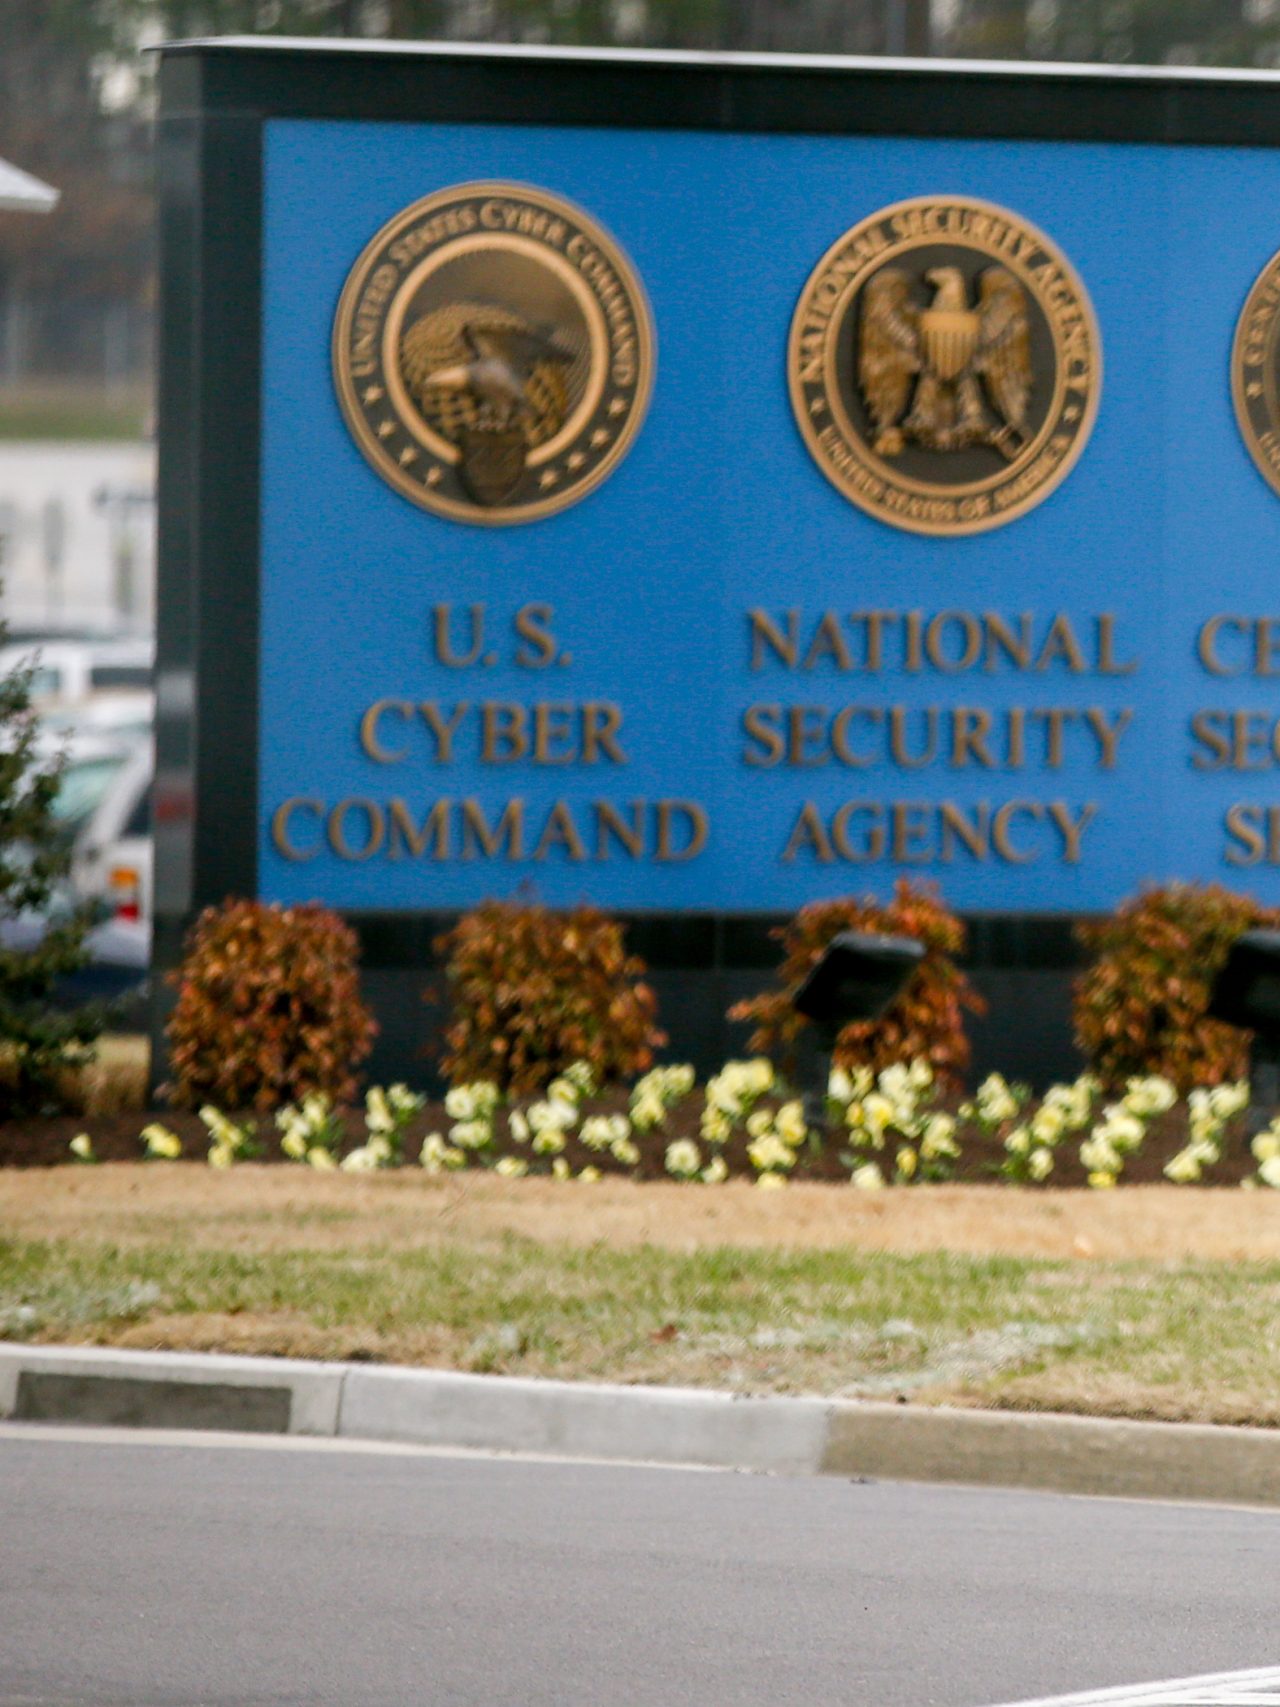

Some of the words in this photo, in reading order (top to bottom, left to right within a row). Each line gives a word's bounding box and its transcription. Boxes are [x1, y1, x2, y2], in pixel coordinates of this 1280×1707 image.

[799, 225, 890, 378] NATIONAL
[891, 207, 1035, 261] SECURITY
[1034, 260, 1089, 390] AGENCY
[433, 602, 573, 667] U.S.
[749, 607, 1137, 674] NATIONAL
[359, 698, 627, 766] CYBER
[743, 702, 1132, 769] SECURITY
[270, 796, 710, 862] COMMAND
[783, 798, 1097, 864] AGENCY
